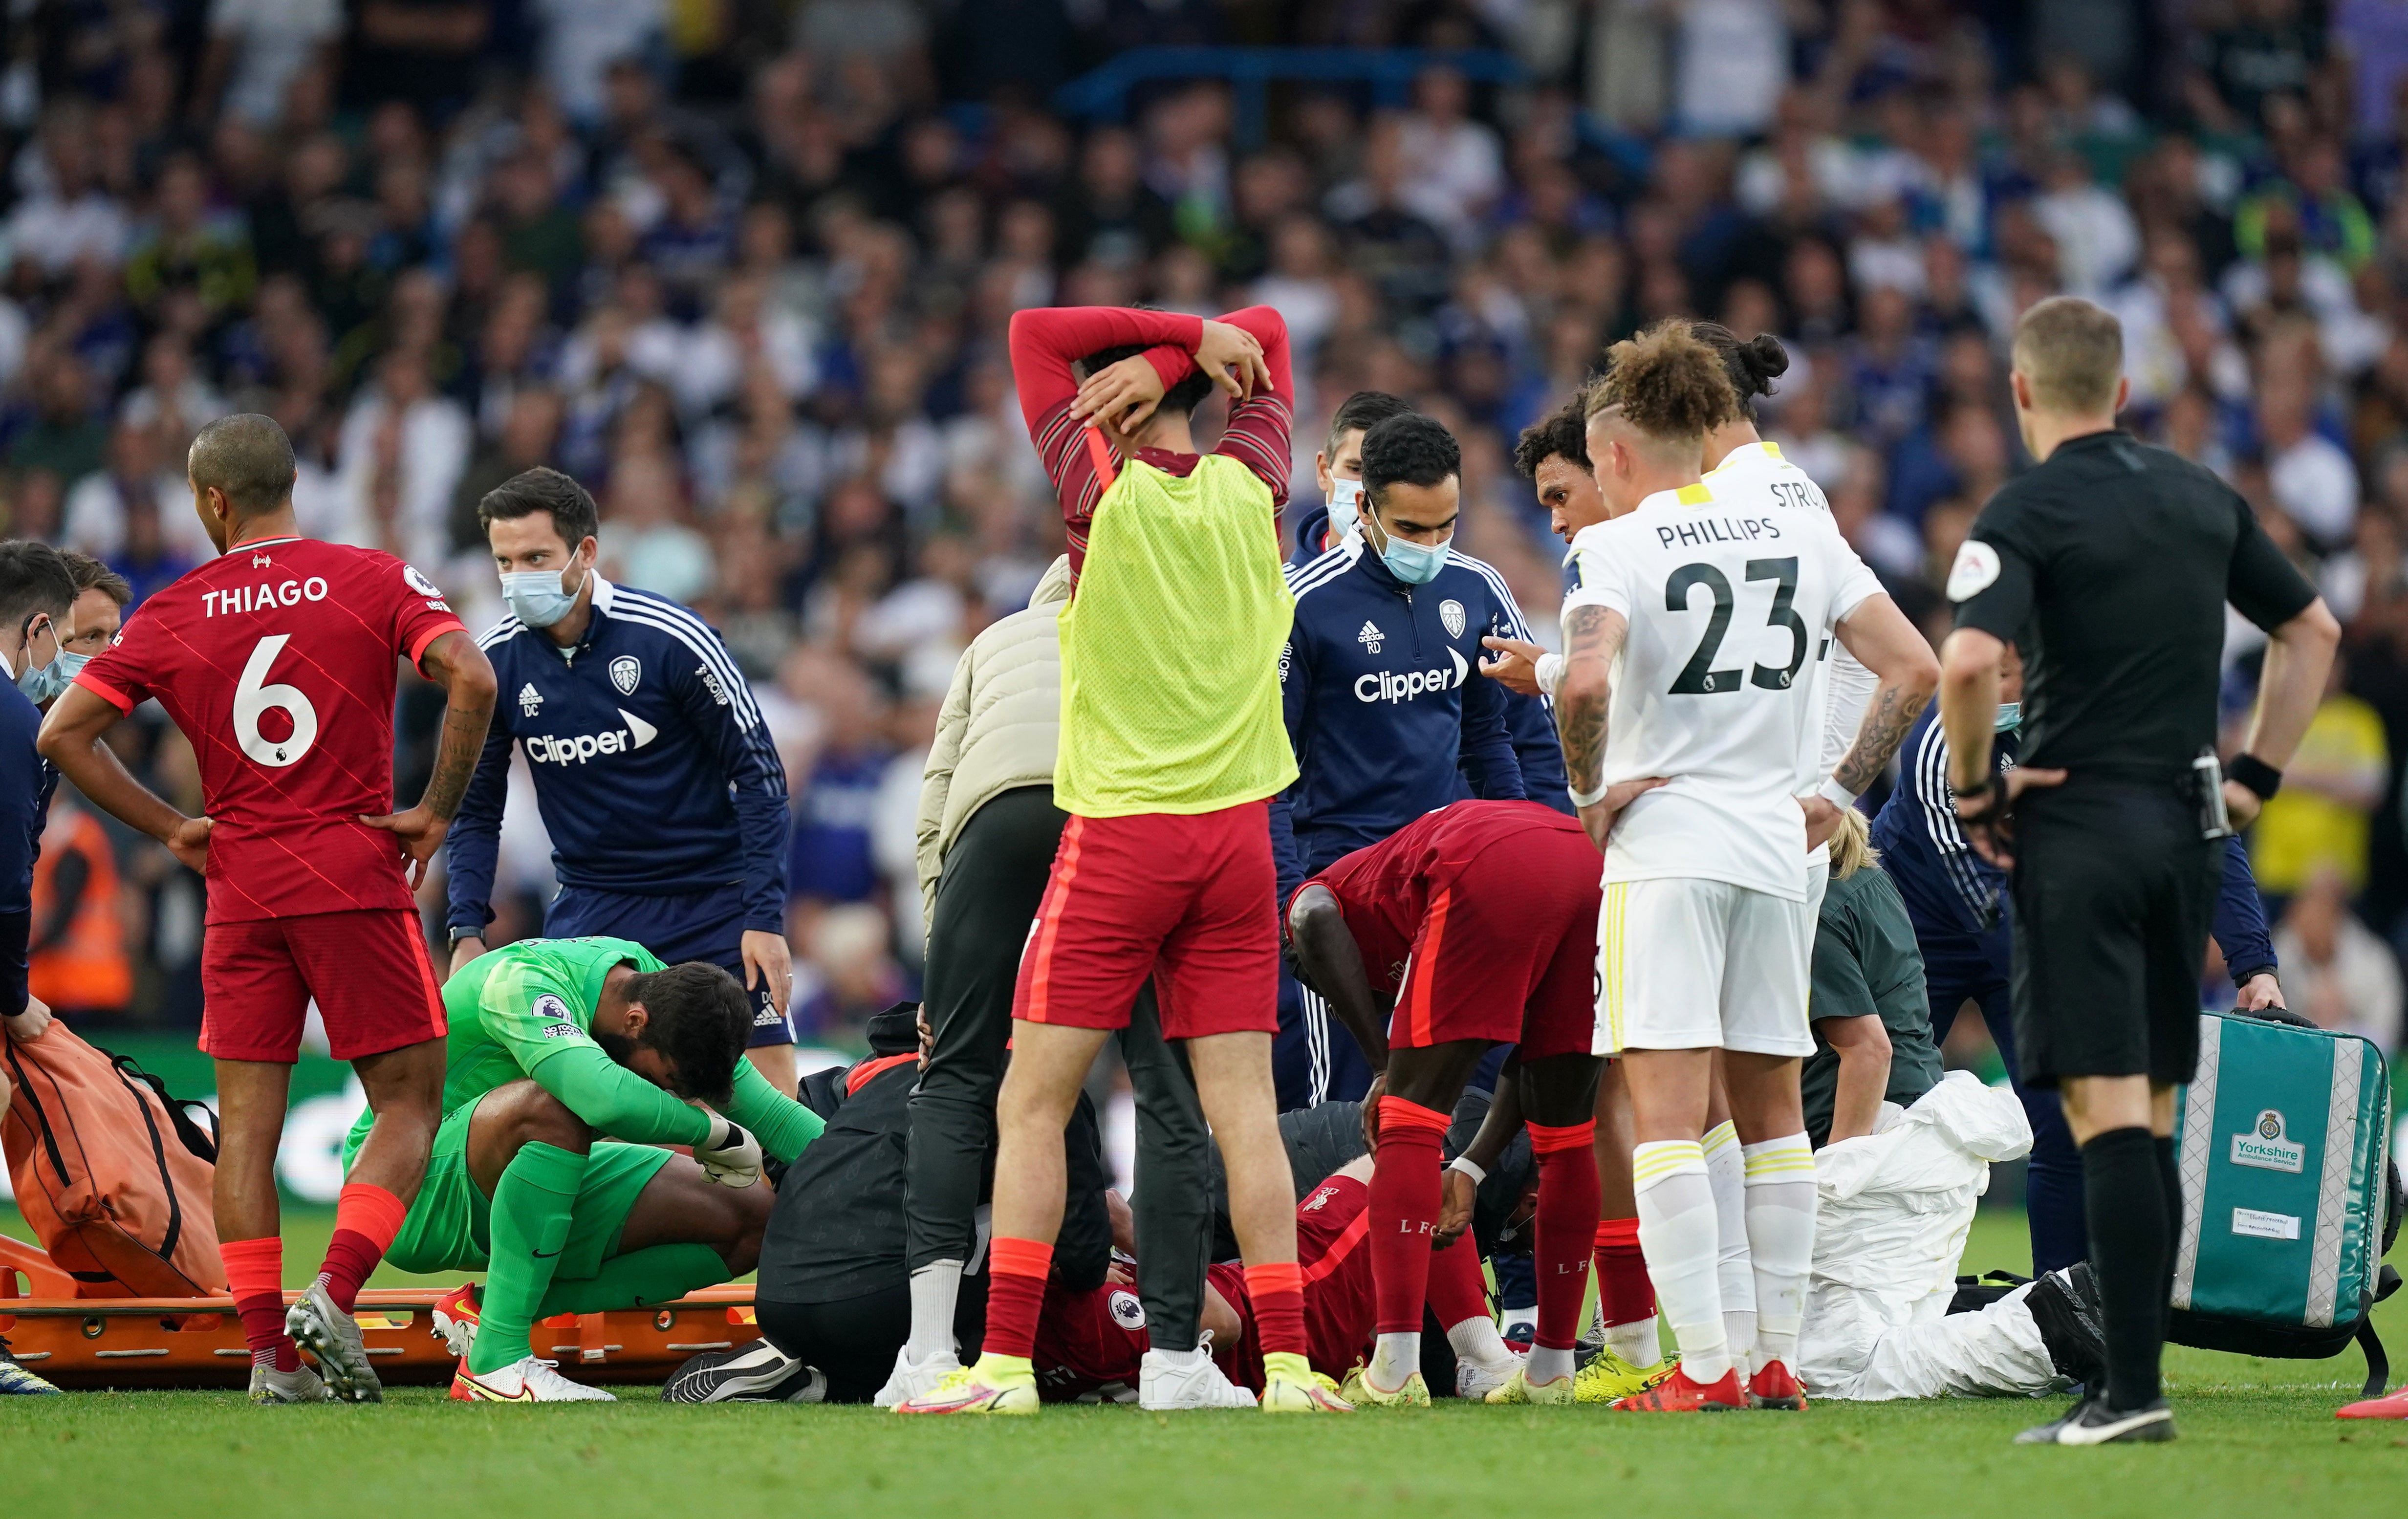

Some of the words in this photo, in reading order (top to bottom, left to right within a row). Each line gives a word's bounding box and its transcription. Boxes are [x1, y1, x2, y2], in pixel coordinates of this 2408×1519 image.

[1656, 518, 1780, 549] PHILLIPS
[201, 576, 328, 618] THIAGO
[1358, 632, 1385, 643] adidas
[1666, 556, 1807, 694] 23
[1367, 641, 1381, 654] RD
[233, 633, 318, 767] 6
[703, 674, 729, 705] SBOTOP
[1354, 668, 1452, 704] Clipper
[524, 704, 539, 717] DC
[526, 729, 628, 767] Clipper
[2237, 1152, 2272, 1162] Ambulance
[2273, 1157, 2296, 1166] Service
[2238, 1141, 2298, 1160] Yorkshire
